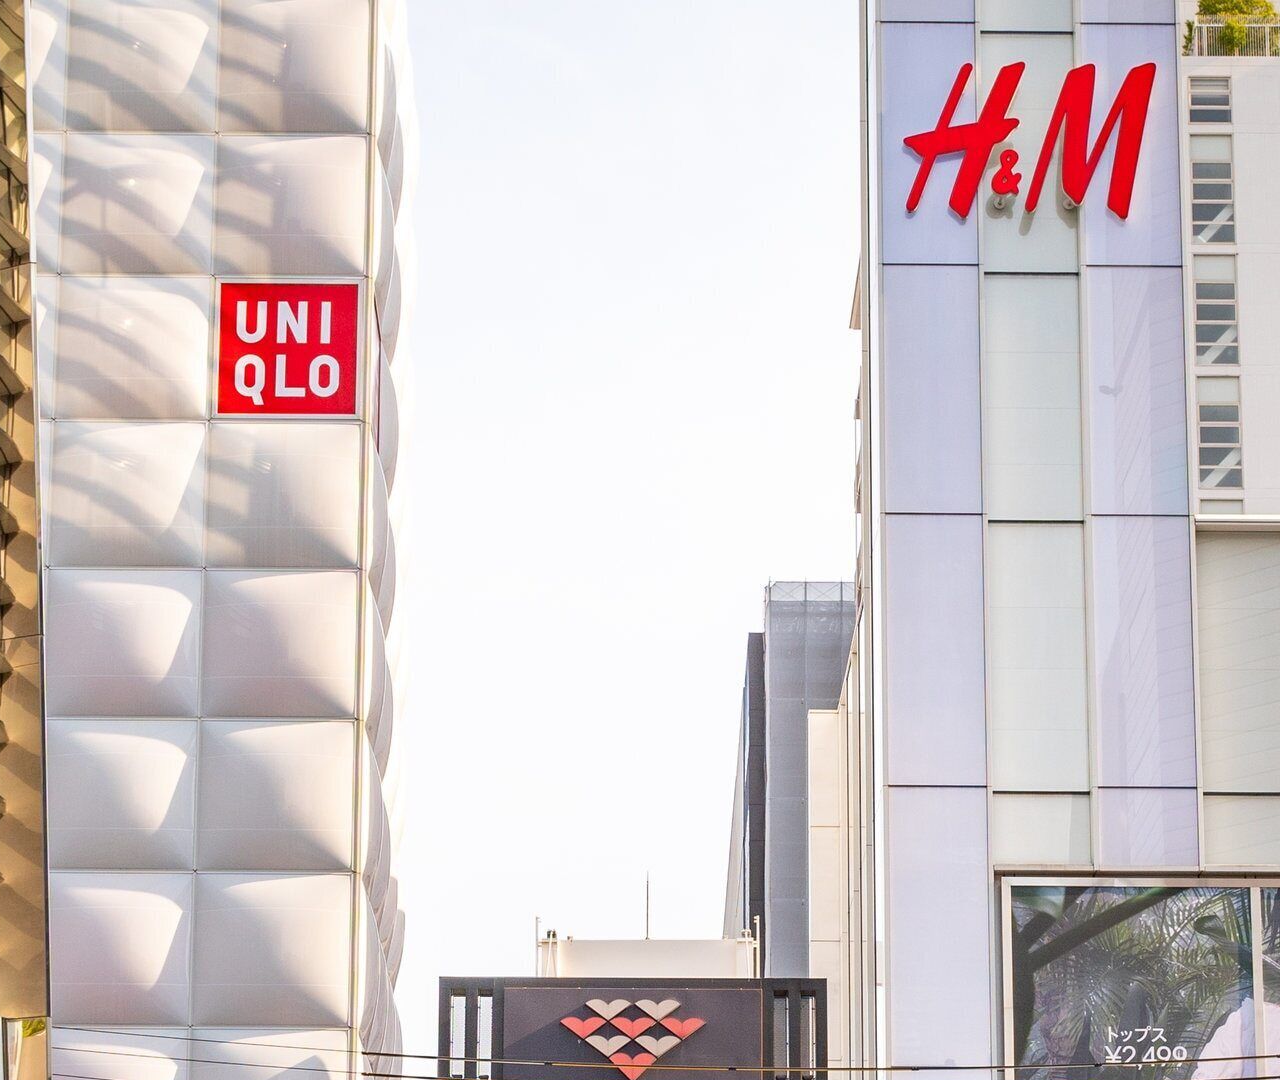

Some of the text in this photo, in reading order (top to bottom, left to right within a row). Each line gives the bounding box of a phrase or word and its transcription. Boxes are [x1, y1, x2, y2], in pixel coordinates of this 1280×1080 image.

[903, 61, 1157, 221] H&M
[236, 300, 332, 344] UNI
[234, 353, 341, 406] QLO
[1106, 1025, 1168, 1043] トップス
